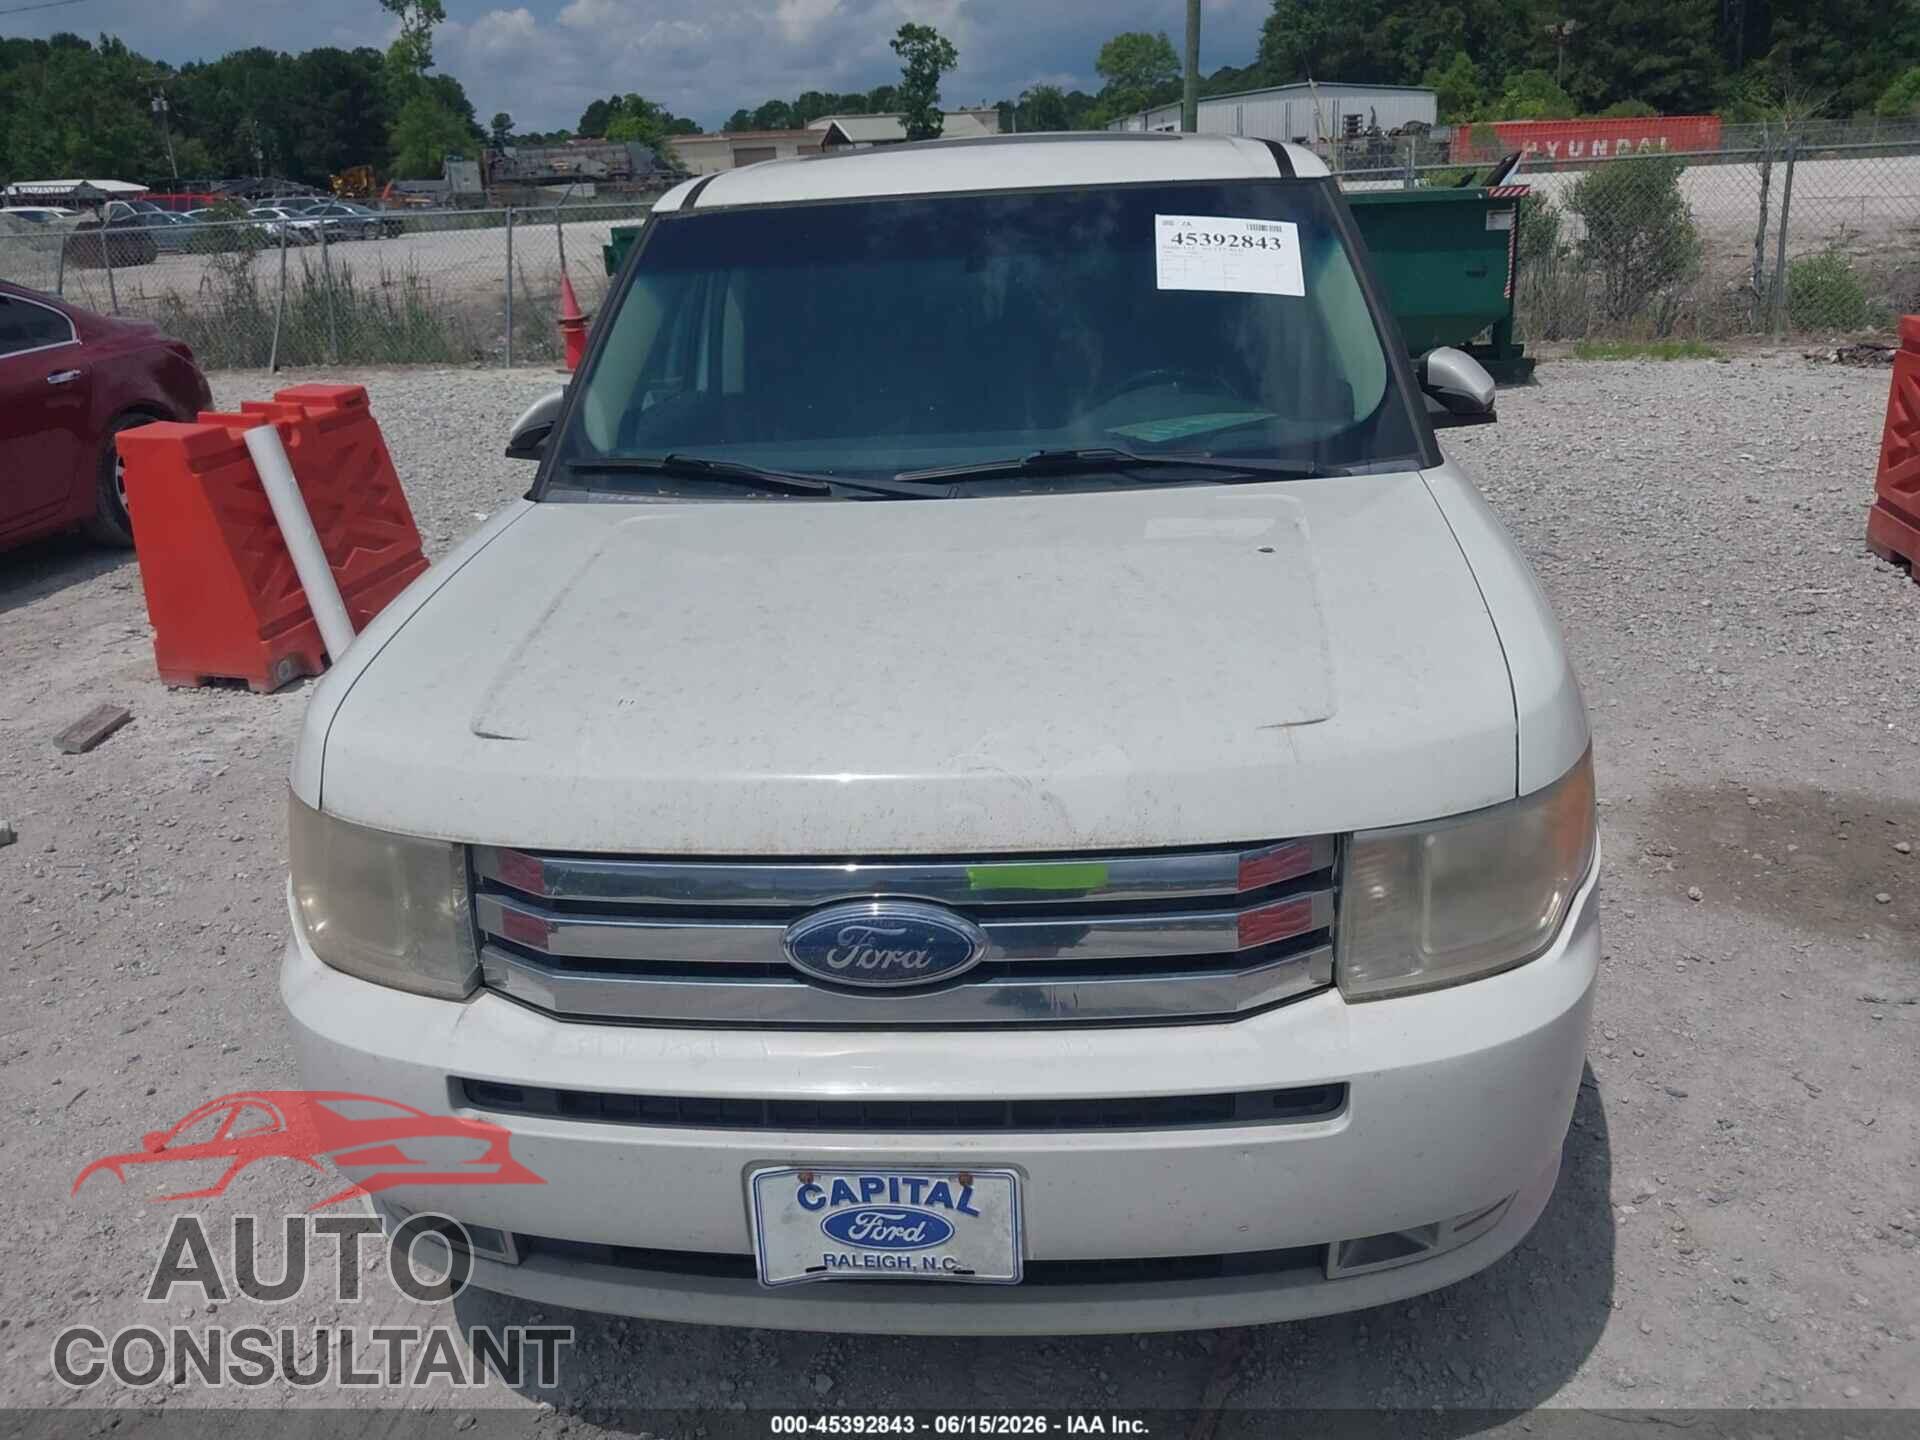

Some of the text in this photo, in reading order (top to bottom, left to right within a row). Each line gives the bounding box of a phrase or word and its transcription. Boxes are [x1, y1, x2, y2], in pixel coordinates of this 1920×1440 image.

[1522, 137, 1668, 158] HYUNDAI
[1171, 232, 1282, 251] 45392843
[826, 925, 935, 969] Ford
[797, 1177, 980, 1217] CAPITAL
[848, 1212, 926, 1242] Ford
[823, 1254, 917, 1270] RALEIGH,
